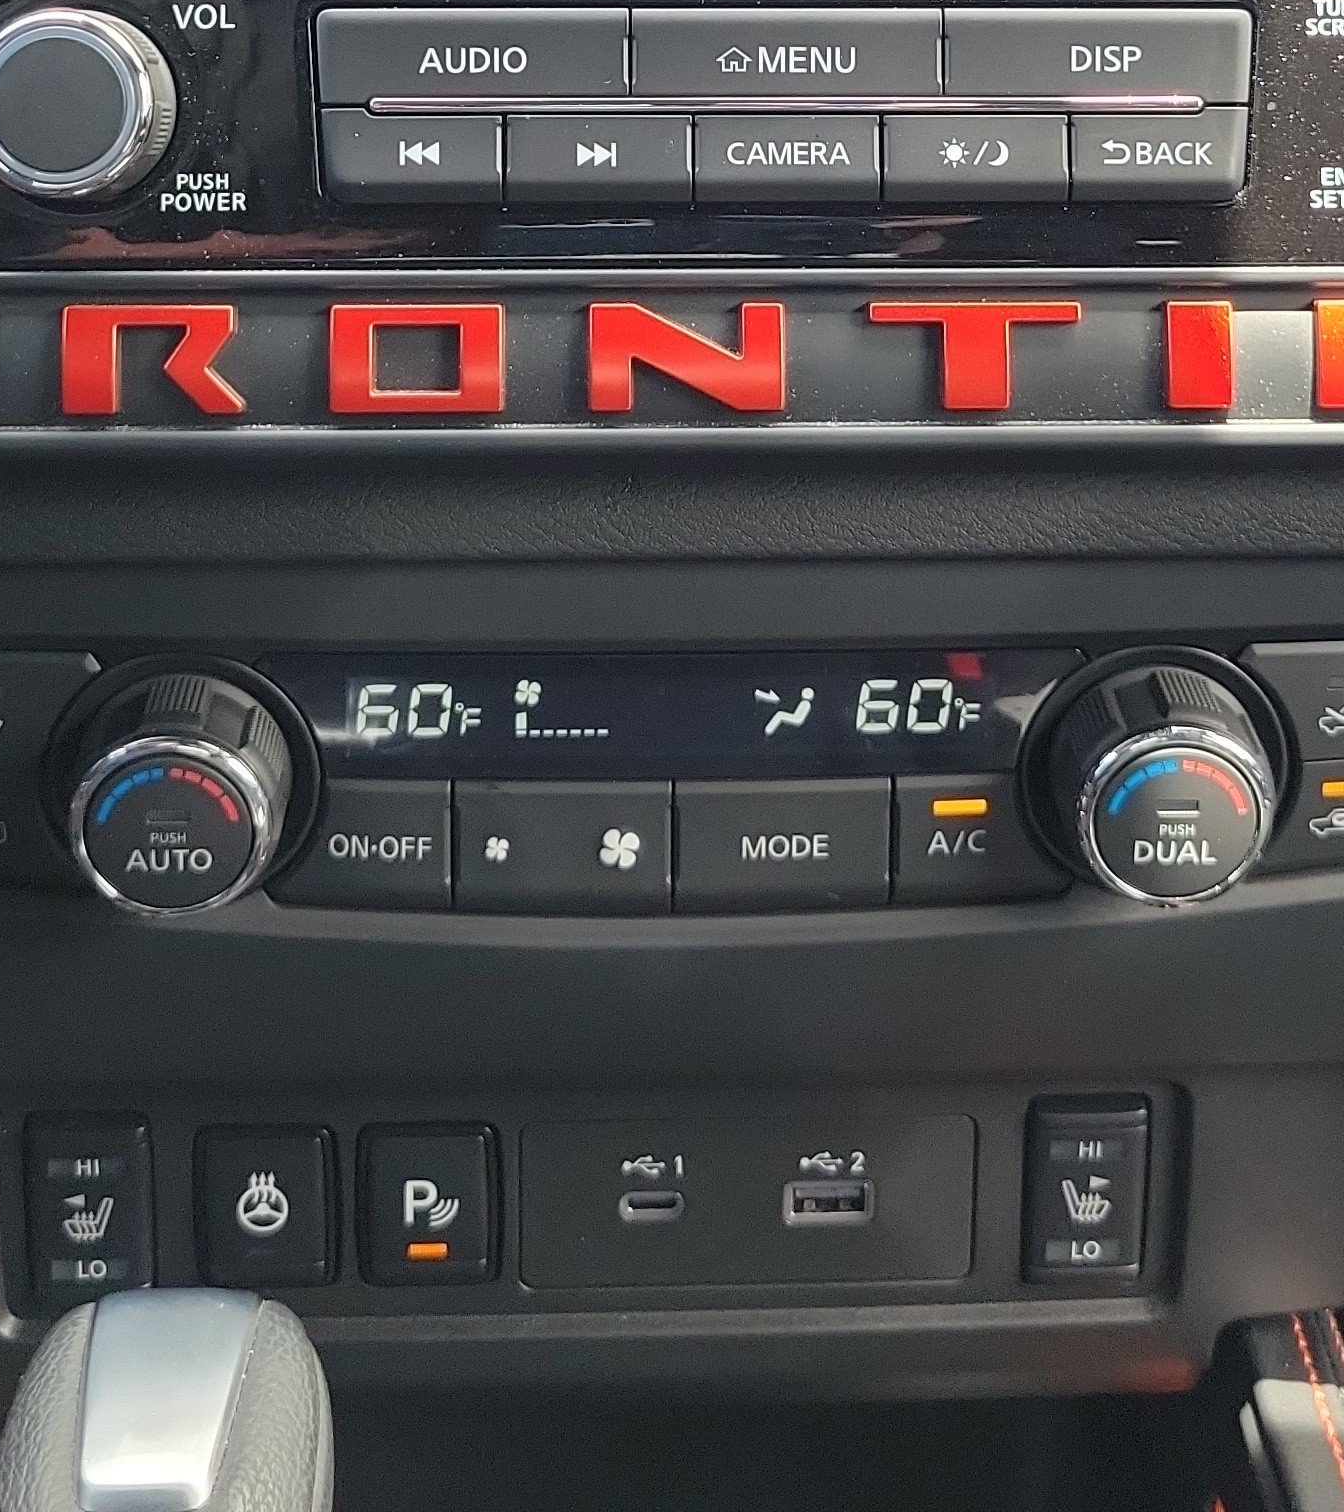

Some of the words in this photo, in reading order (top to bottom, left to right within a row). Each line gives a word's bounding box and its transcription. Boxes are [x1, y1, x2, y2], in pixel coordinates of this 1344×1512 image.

[172, 3, 236, 30] VOL
[418, 46, 528, 75] AUDIO
[758, 45, 857, 74] MENU
[1069, 45, 1143, 73] DISP
[726, 141, 851, 167] CAMERA
[1136, 141, 1212, 167] BACK
[175, 172, 229, 192] PUSH
[159, 192, 247, 213] POWER
[149, 831, 187, 845] PUSH
[1159, 823, 1196, 837] PUSH
[741, 835, 830, 860] MODE
[927, 830, 987, 857] A/C
[1133, 840, 1217, 867] DUAL
[125, 847, 214, 874] AUTO
[1078, 1140, 1104, 1159] HI
[75, 1158, 100, 1177] HI
[673, 1155, 685, 1177] 1
[851, 1151, 866, 1173] 2
[1071, 1242, 1101, 1260] LO
[77, 1260, 107, 1278] LO
